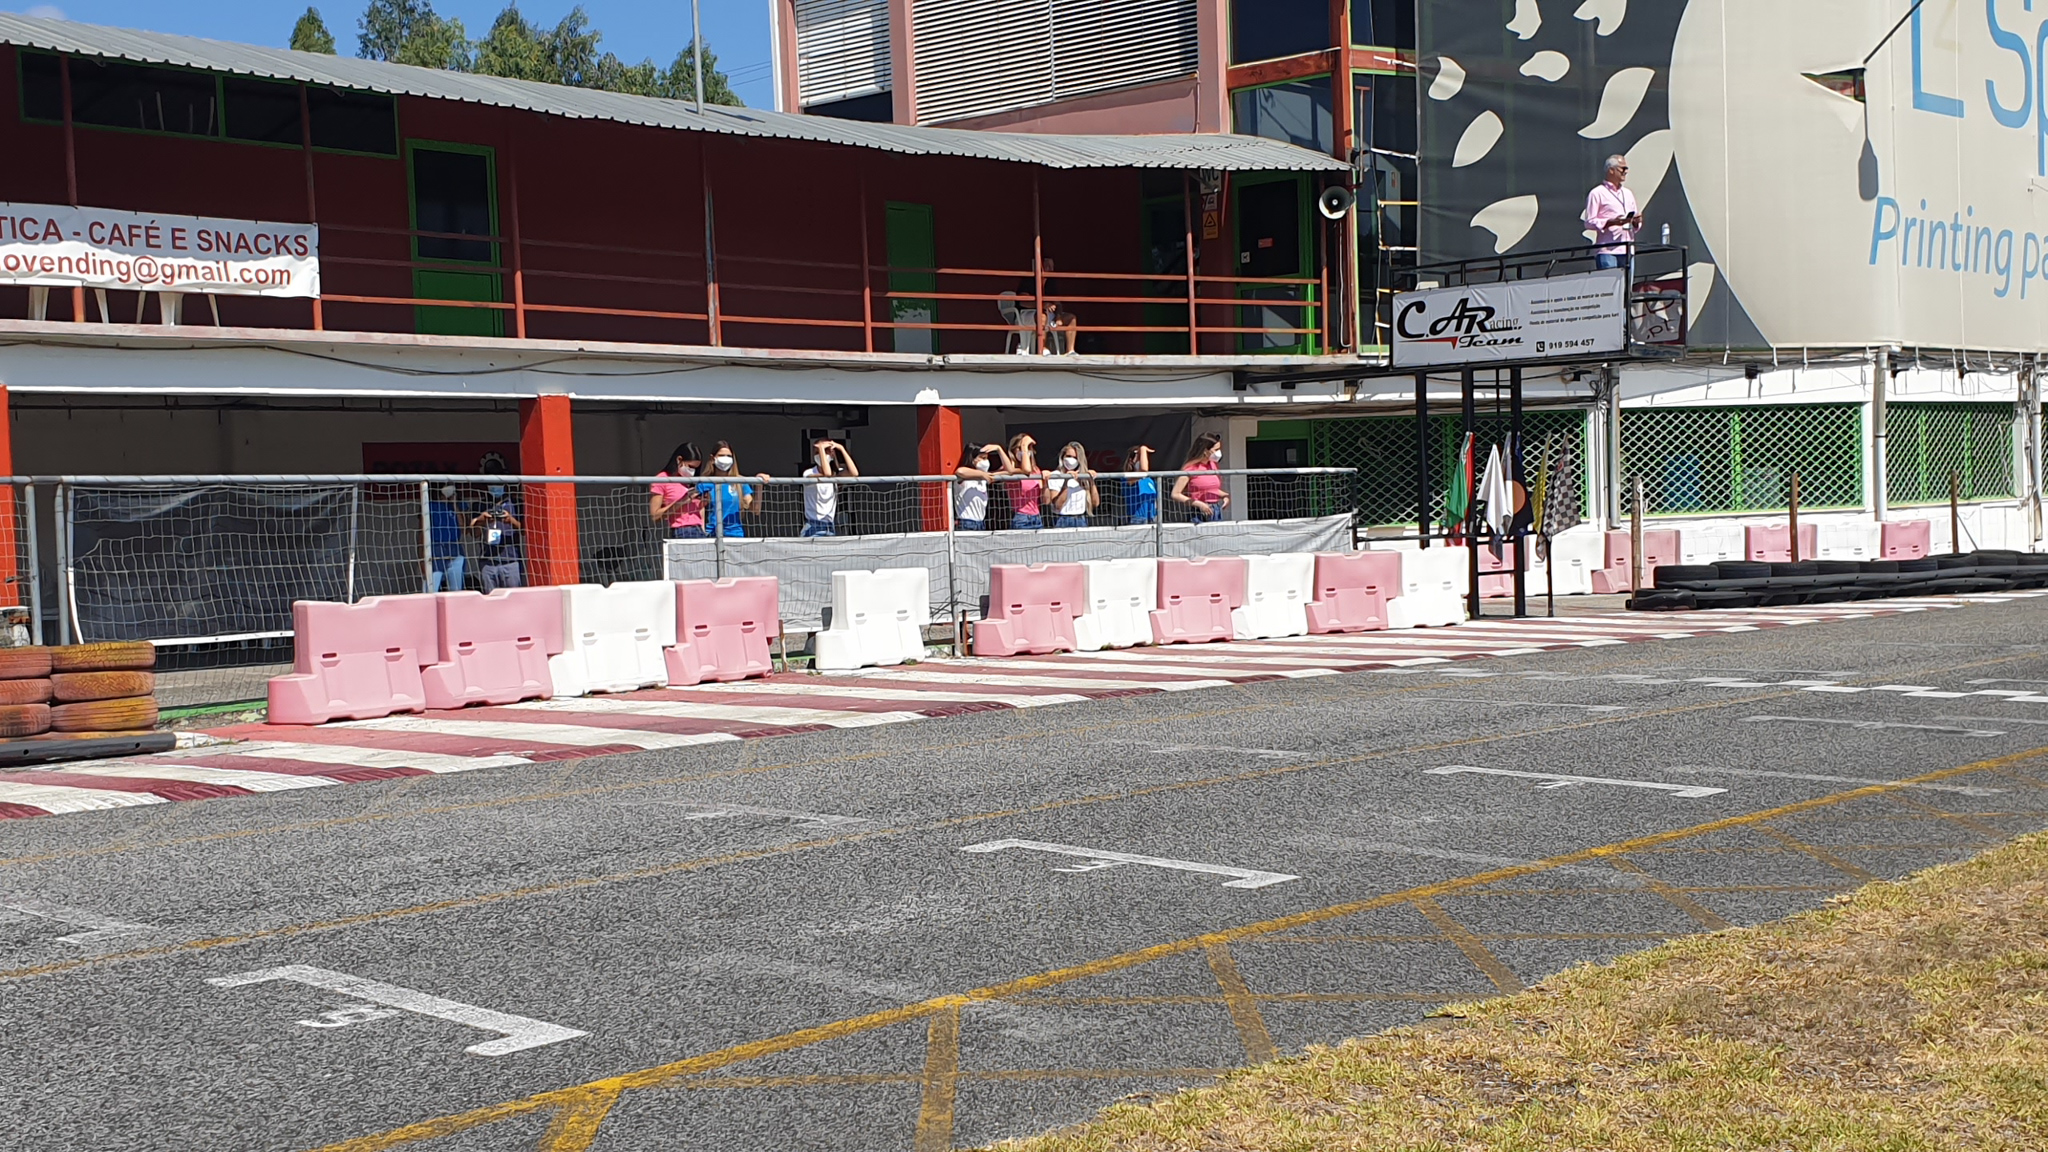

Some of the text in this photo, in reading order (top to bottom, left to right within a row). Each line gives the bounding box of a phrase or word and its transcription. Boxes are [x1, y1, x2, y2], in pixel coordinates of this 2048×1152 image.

[88, 219, 162, 249] CAFÉ
[172, 227, 188, 250] E
[197, 229, 309, 257] SNACKS
[1868, 196, 2014, 298] Printing
[1581, 338, 1595, 346] 457
